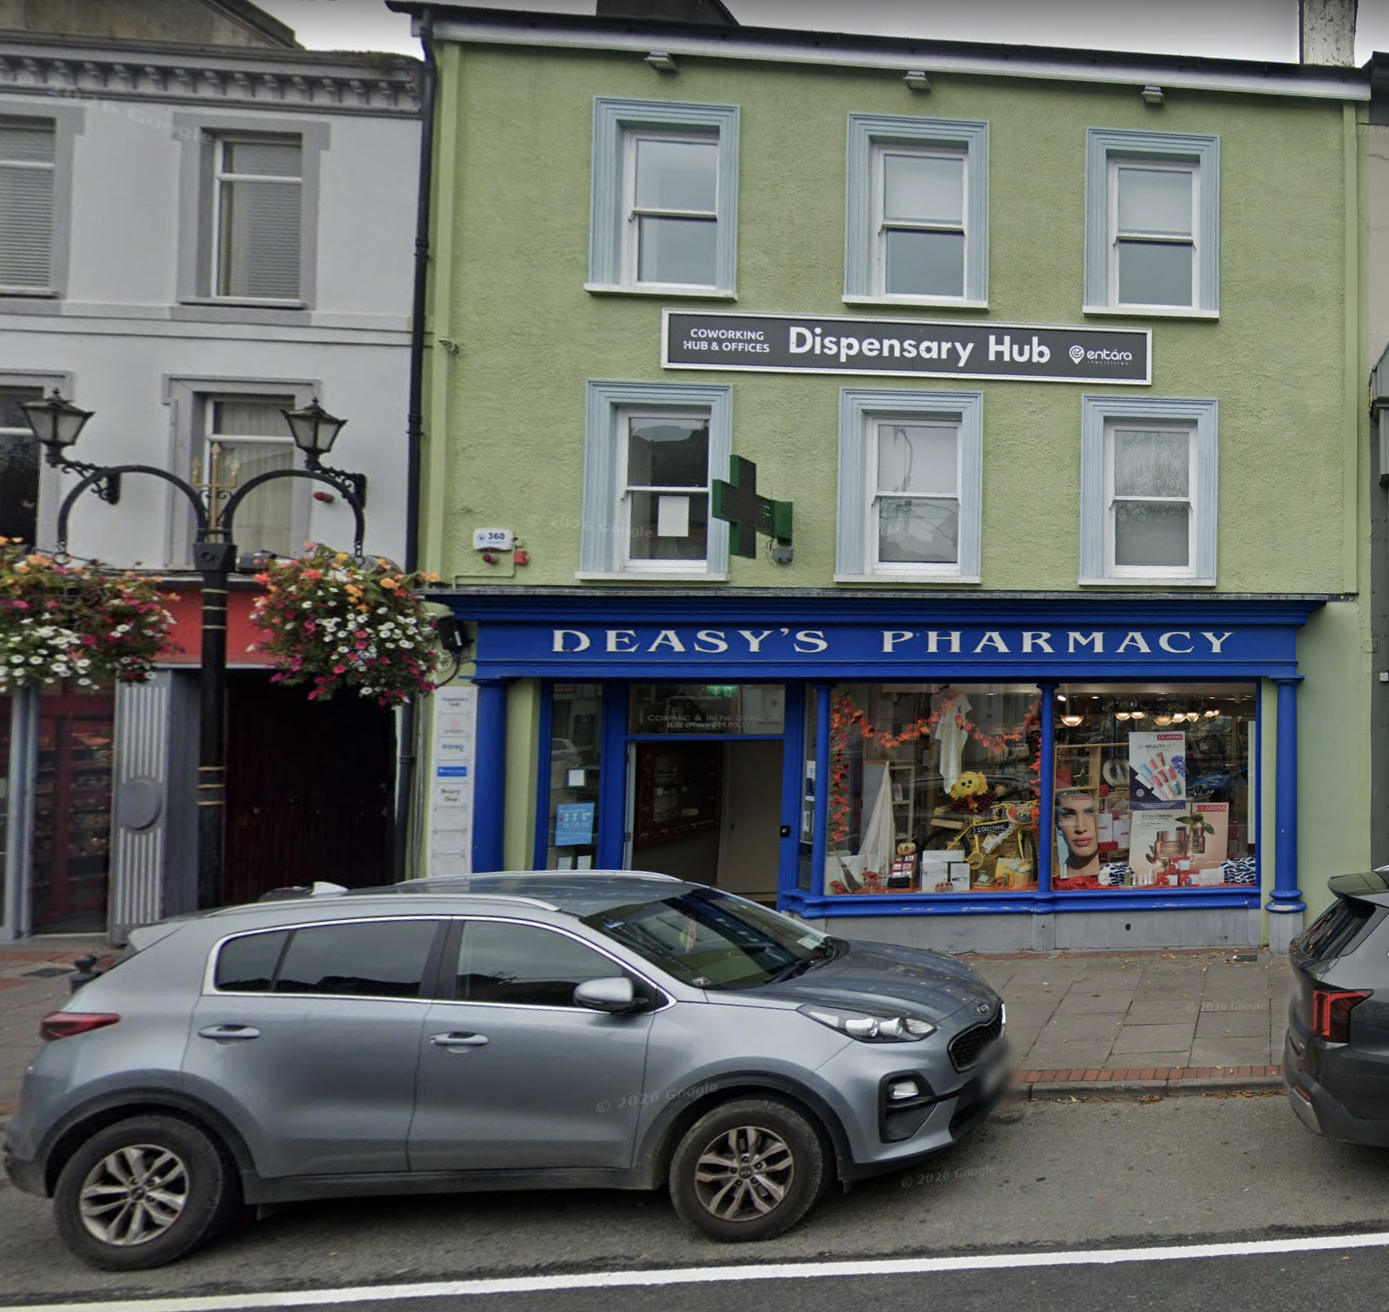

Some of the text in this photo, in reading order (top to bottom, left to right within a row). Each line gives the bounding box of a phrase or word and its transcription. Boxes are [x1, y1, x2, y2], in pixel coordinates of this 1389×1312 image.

[690, 328, 764, 341] COWORKING
[683, 340, 771, 354] HUB & OFFICES
[788, 326, 1051, 368] Dispensary Hub
[1086, 348, 1133, 361] entára
[487, 531, 506, 541] 360
[552, 629, 1235, 654] DEASY'S PHARMACY
[647, 714, 690, 722] CORMAC
[694, 714, 703, 722] &
